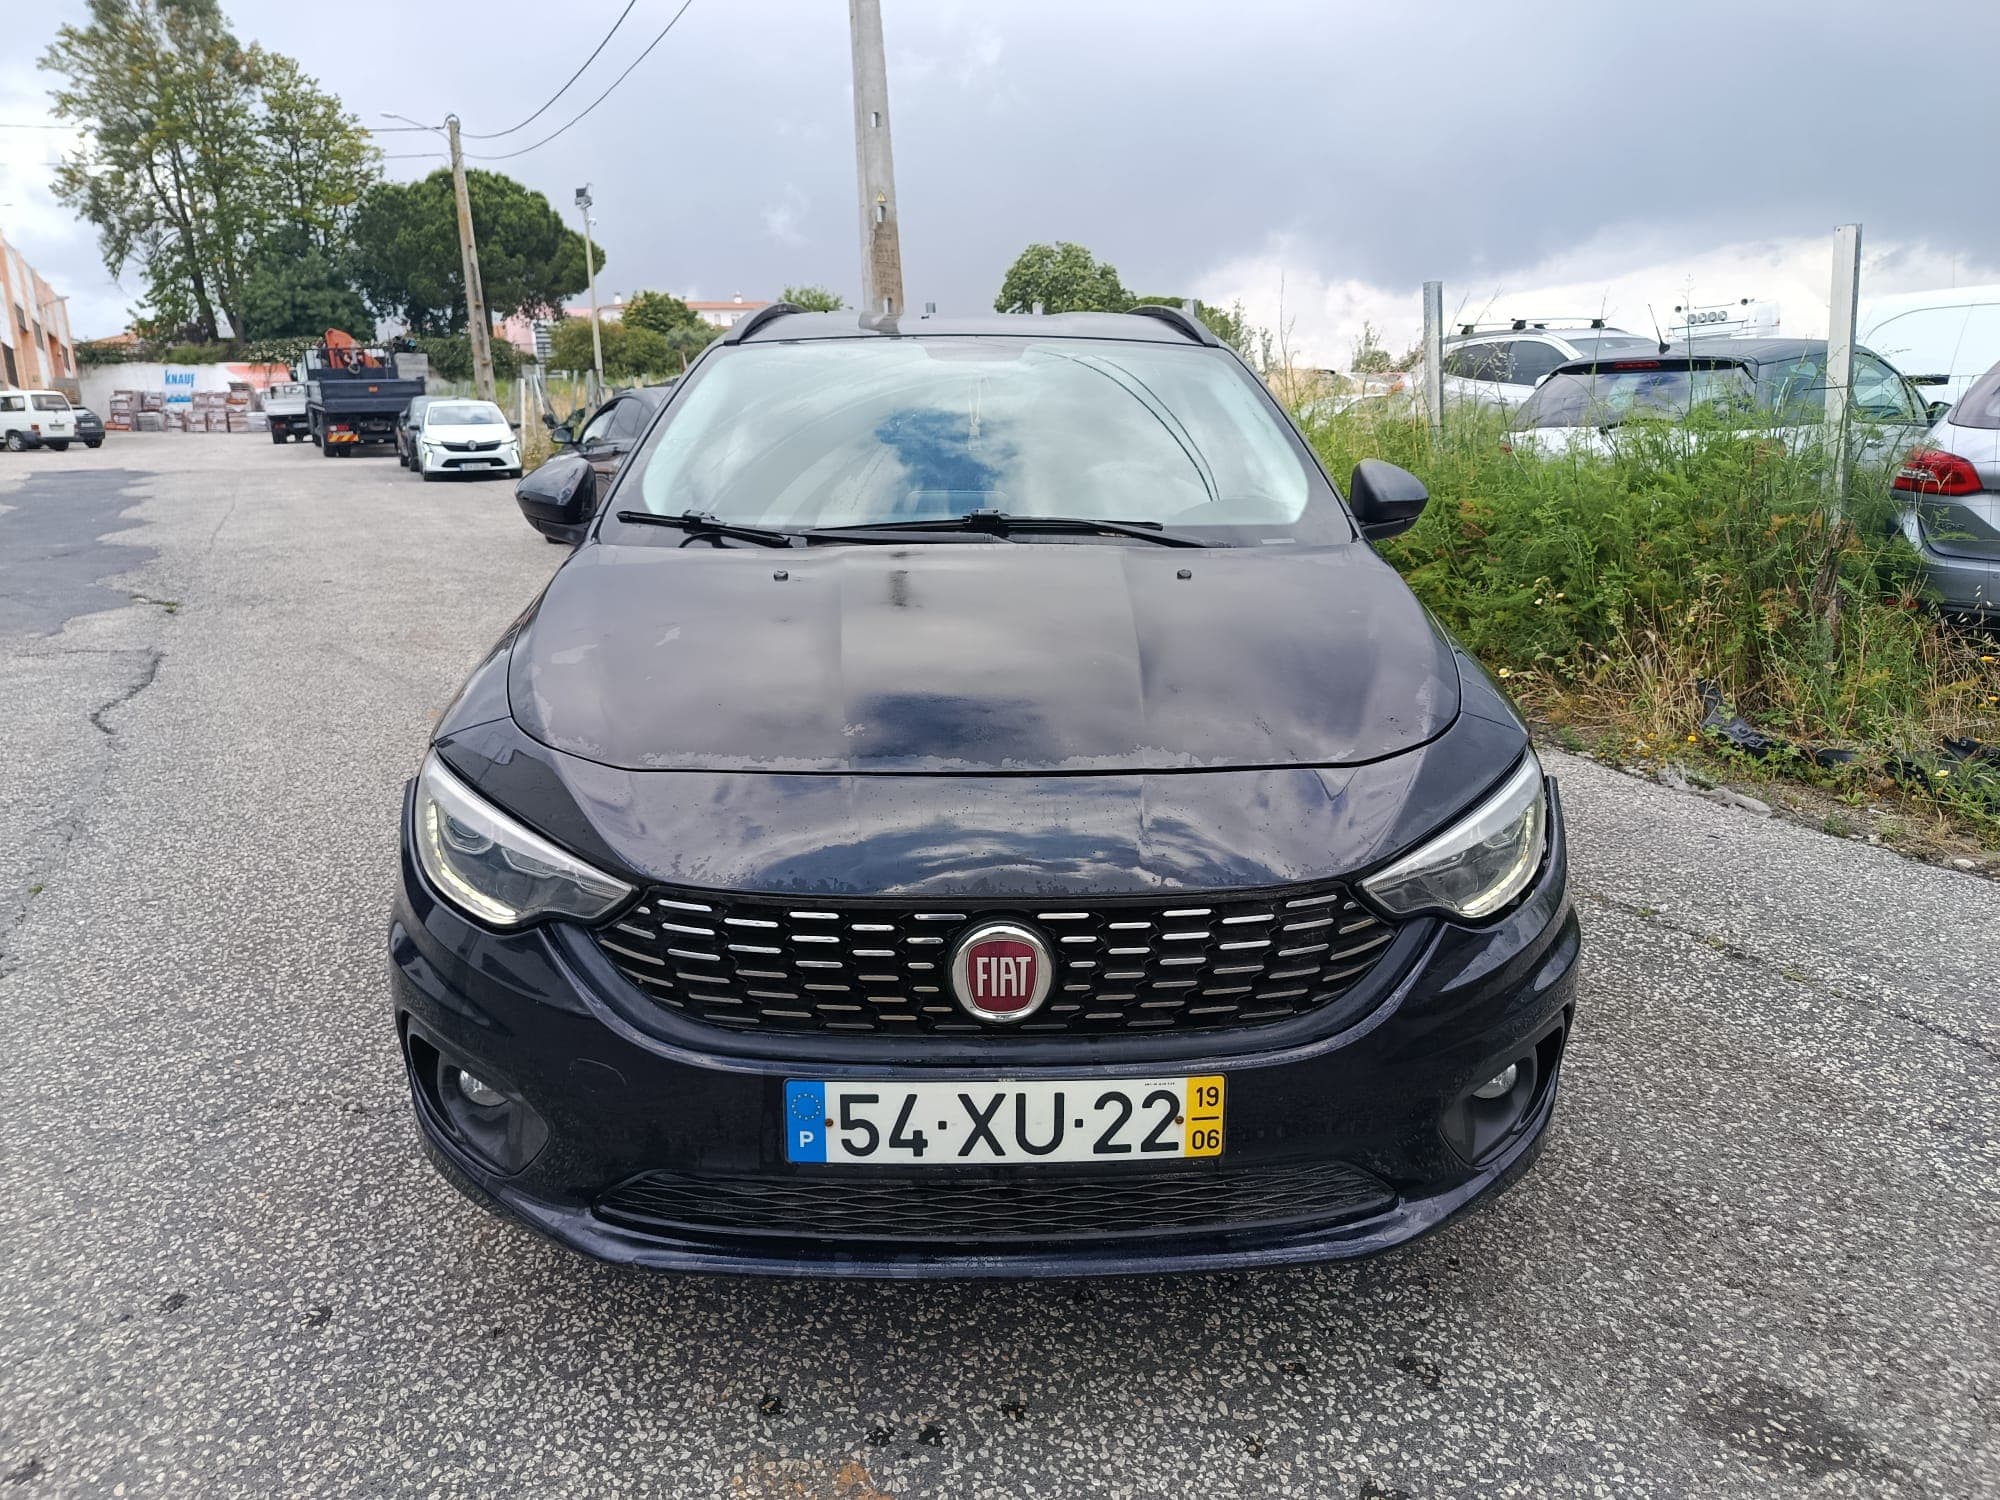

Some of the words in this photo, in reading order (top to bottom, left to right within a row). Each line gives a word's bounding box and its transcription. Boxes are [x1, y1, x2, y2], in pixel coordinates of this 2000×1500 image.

[976, 956, 1032, 997] FIAT
[1196, 1086, 1219, 1107] 19
[799, 1130, 815, 1148] P
[1191, 1129, 1220, 1150] 06
